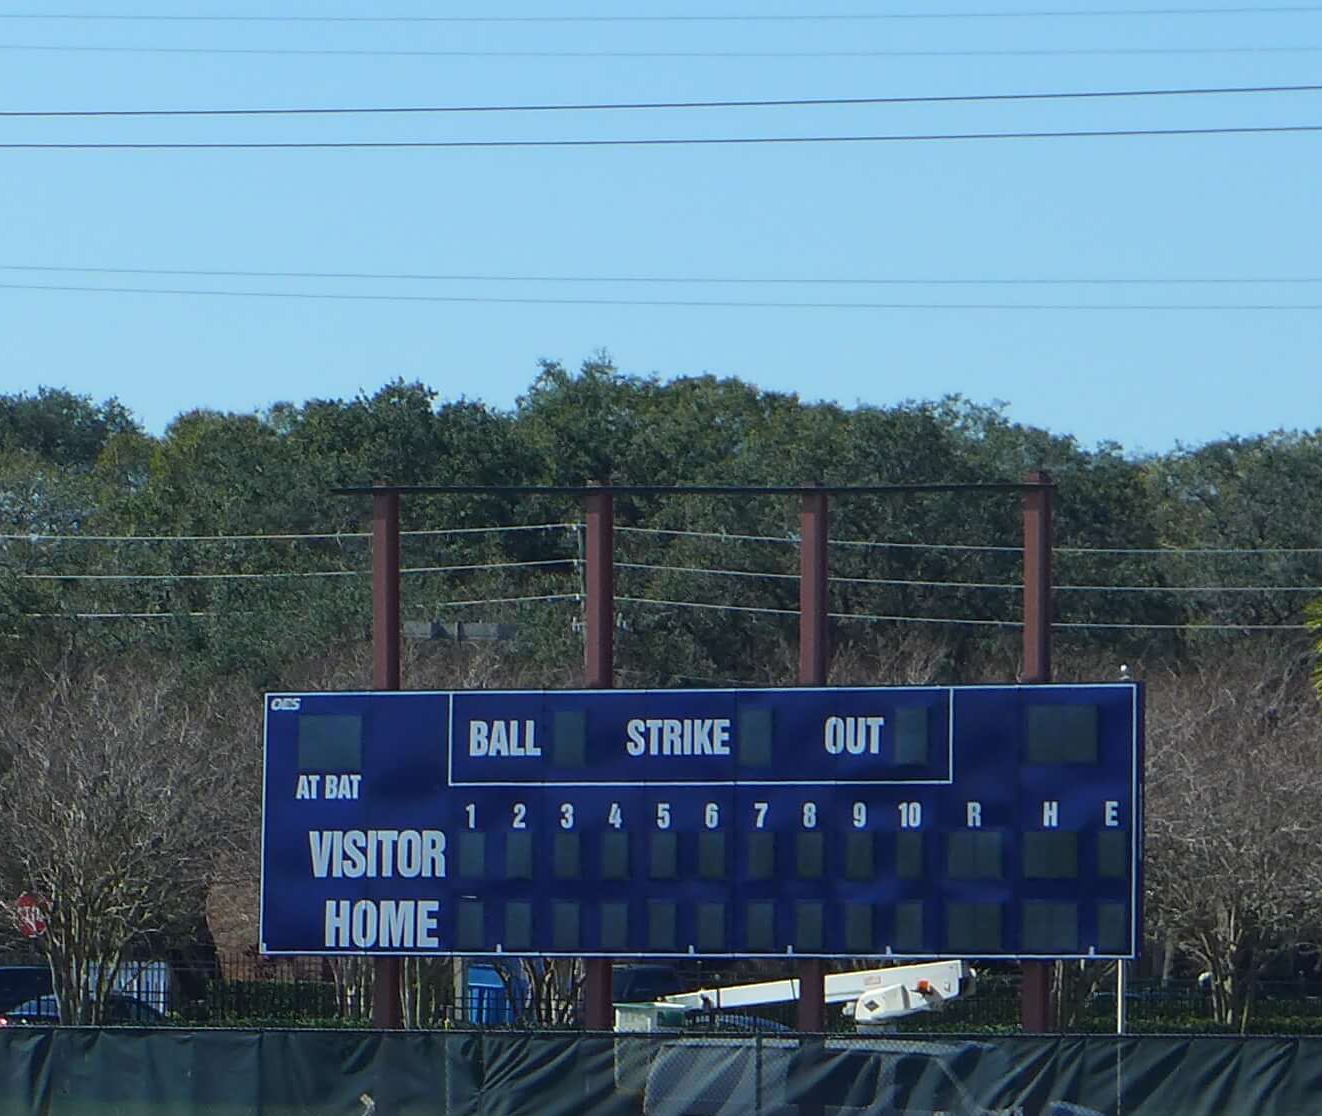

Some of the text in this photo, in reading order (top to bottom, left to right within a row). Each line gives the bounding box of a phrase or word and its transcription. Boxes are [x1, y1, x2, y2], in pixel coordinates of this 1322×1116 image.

[470, 717, 884, 756] BALL STRIKE OUT
[296, 775, 362, 799] AT BAT
[465, 801, 1118, 829] 1 2 3 4 5 6 7 8 9 10 R H E
[309, 830, 445, 877] VISITOR
[325, 900, 439, 947] HOME
